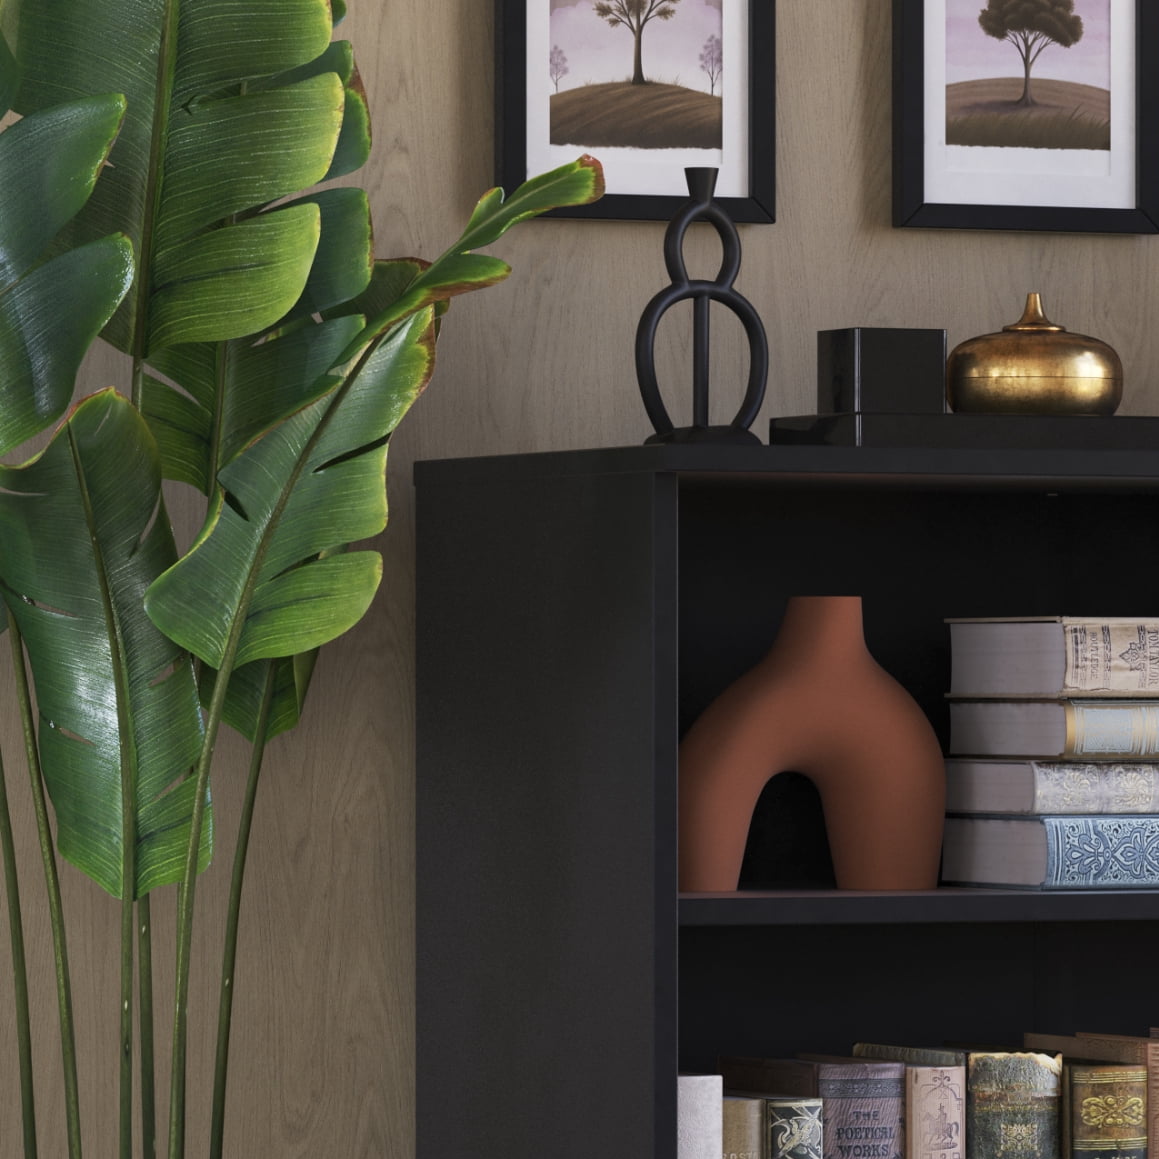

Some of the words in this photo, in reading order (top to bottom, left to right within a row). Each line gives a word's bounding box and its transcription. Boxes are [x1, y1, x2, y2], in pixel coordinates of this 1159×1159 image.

[1147, 629, 1159, 648] TOM
[1147, 651, 1159, 685] TAYLOR
[853, 1110, 880, 1121] THE
[836, 1126, 895, 1140] POETICAL
[838, 1144, 889, 1157] WORKS
